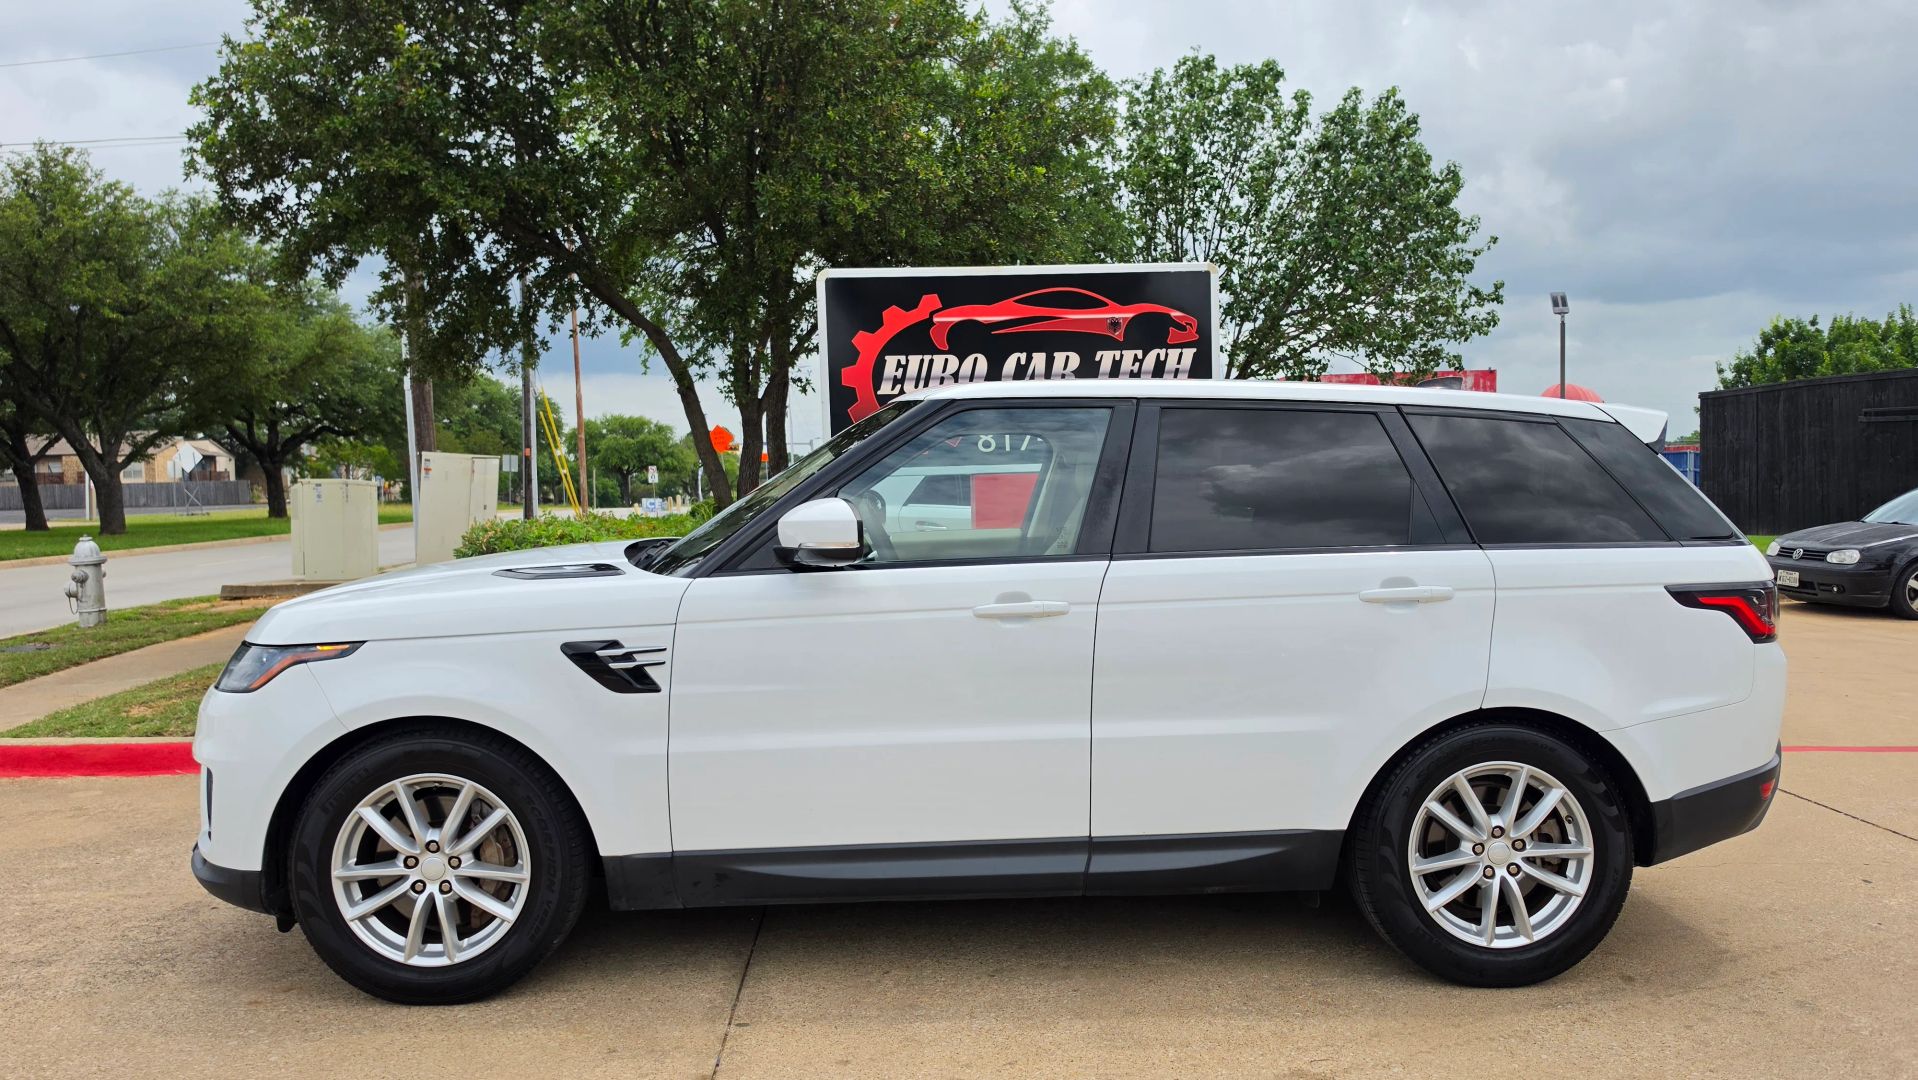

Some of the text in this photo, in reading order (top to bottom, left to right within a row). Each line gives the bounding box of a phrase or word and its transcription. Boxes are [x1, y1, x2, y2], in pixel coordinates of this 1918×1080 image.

[877, 347, 1198, 395] EURO CAR TECH
